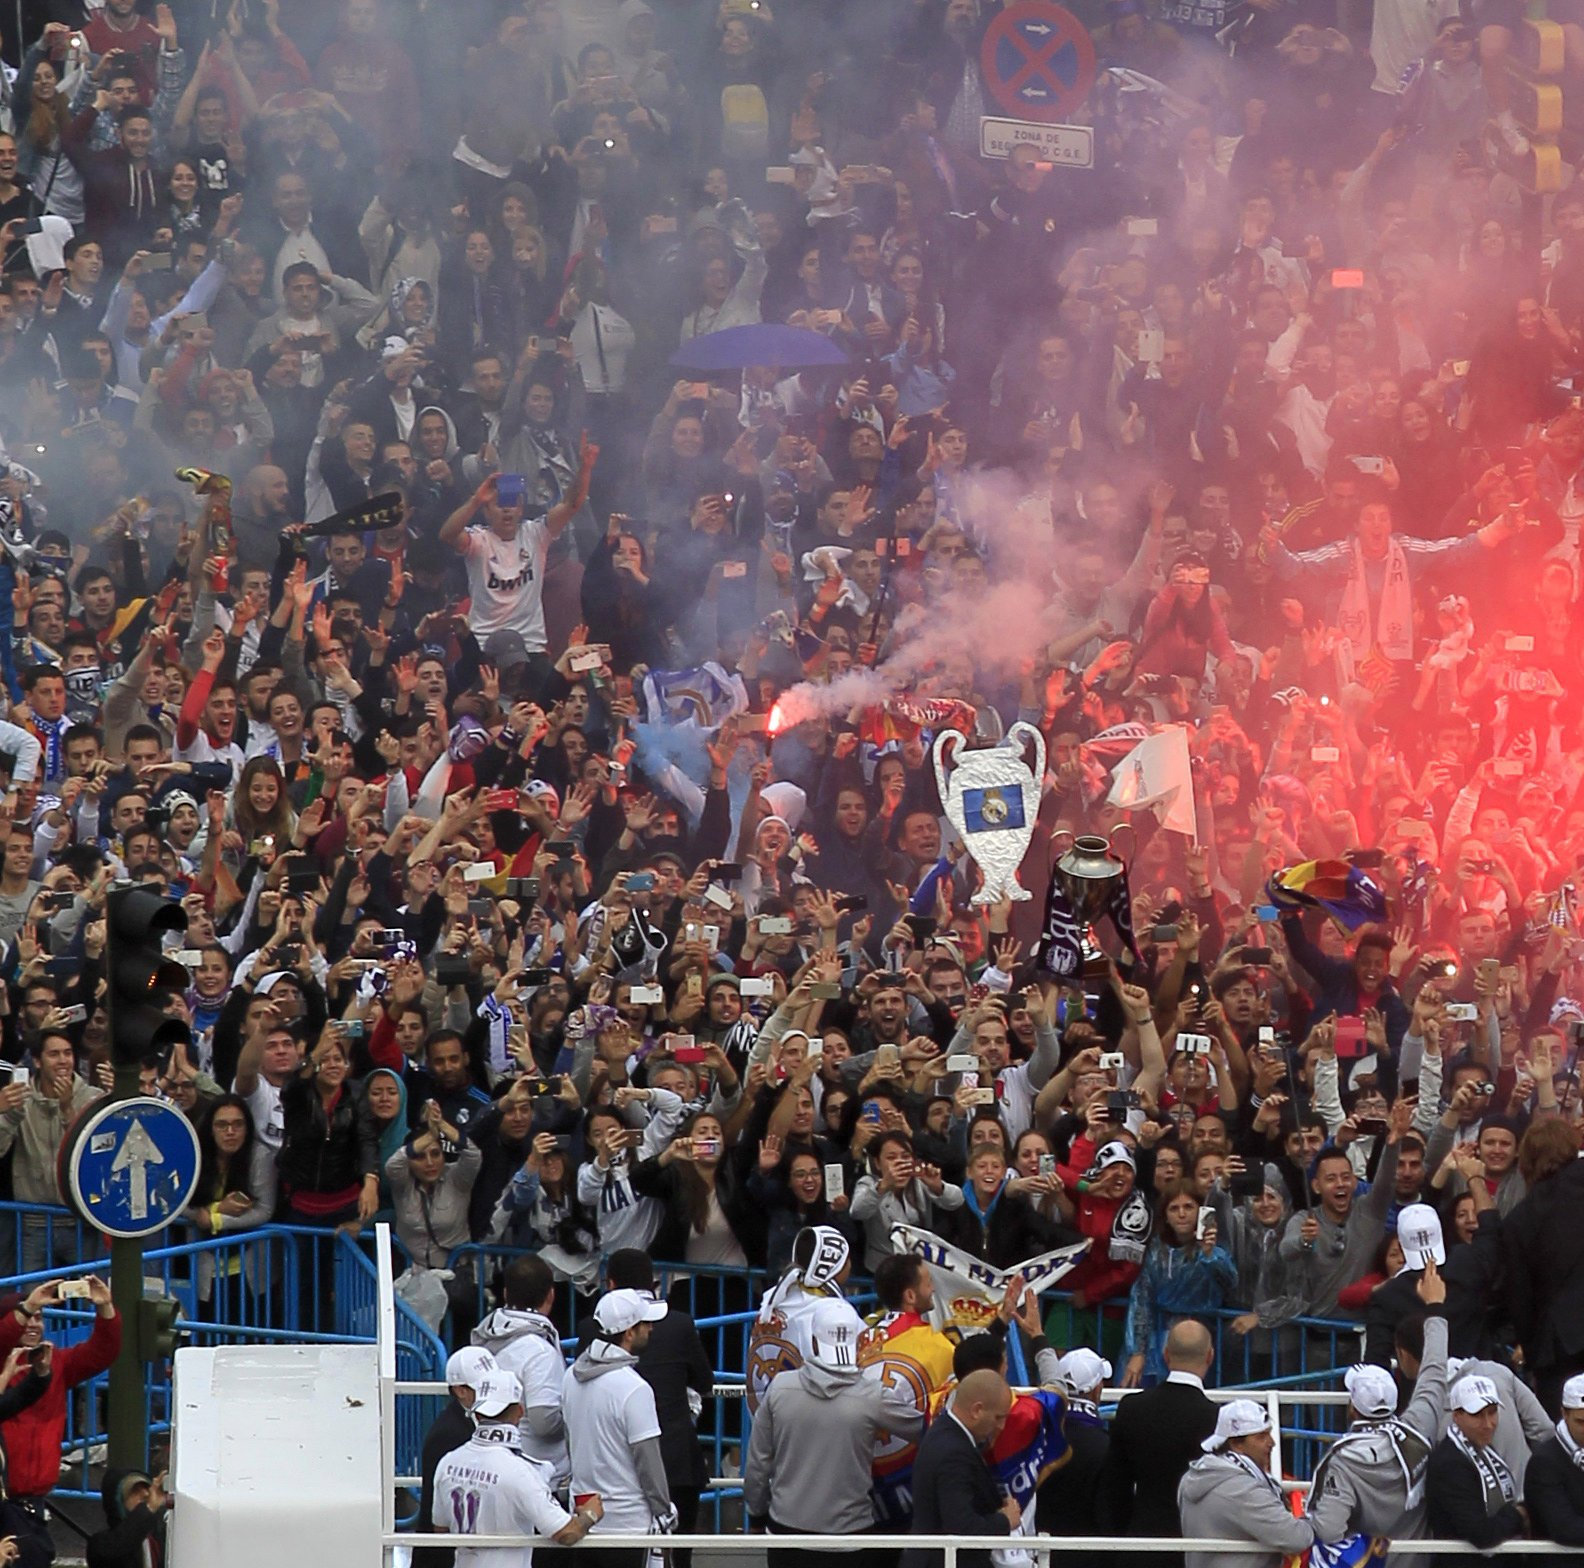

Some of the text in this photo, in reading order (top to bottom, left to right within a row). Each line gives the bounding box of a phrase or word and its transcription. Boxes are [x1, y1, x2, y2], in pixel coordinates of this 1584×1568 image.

[1014, 130, 1061, 144] ZONA DE
[487, 567, 533, 591] bwin
